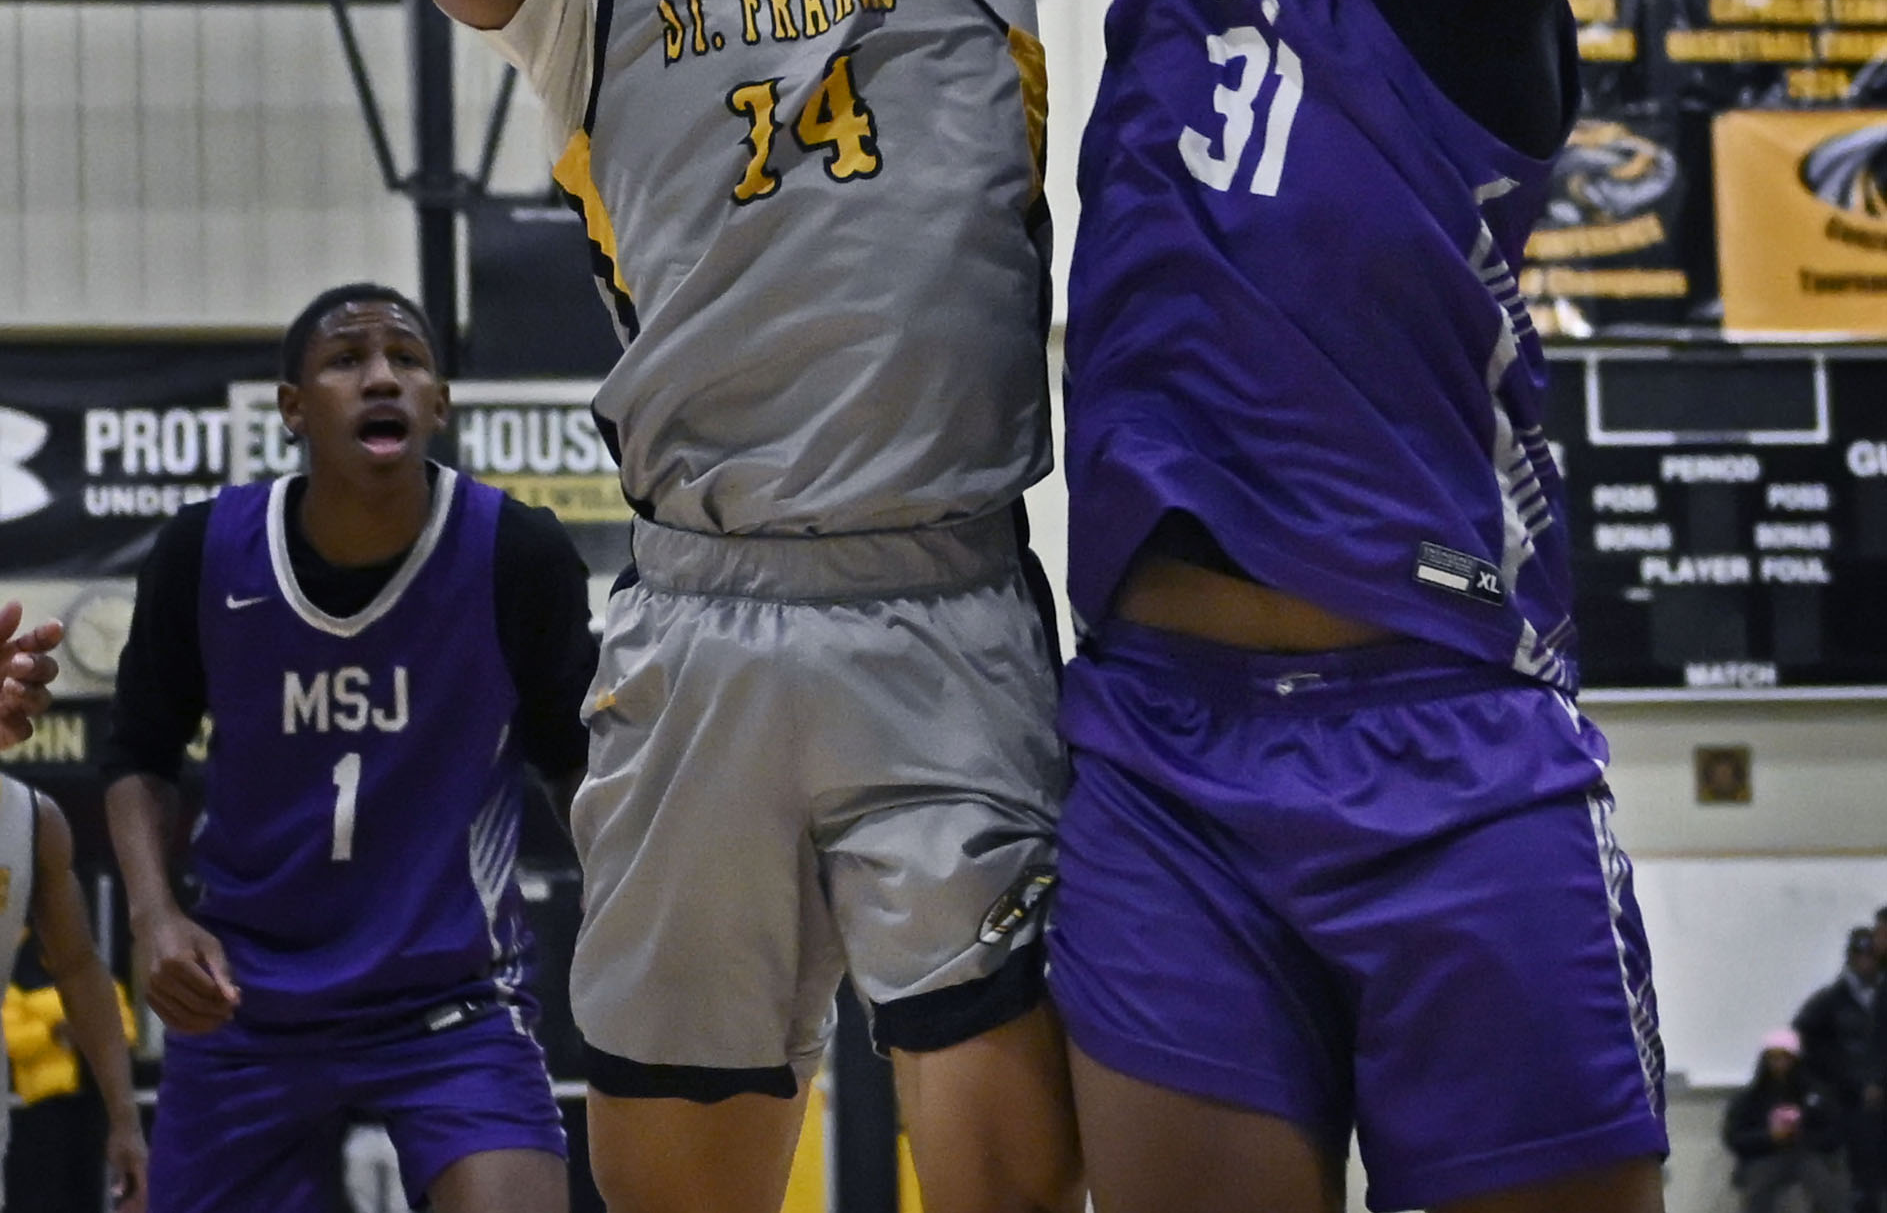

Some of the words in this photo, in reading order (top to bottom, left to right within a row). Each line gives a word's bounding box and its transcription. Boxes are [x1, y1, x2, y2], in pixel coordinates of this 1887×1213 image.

[725, 43, 883, 206] 14
[1177, 25, 1304, 197] 31
[85, 407, 304, 474] PROTEC
[1660, 453, 1761, 483] PERIOD
[1476, 570, 1502, 595] XL
[1640, 554, 1750, 584] PLAYER
[1760, 554, 1832, 584] FOUL
[282, 665, 411, 735] MSJ
[1684, 661, 1777, 688] MATCH
[331, 751, 362, 862] 1
